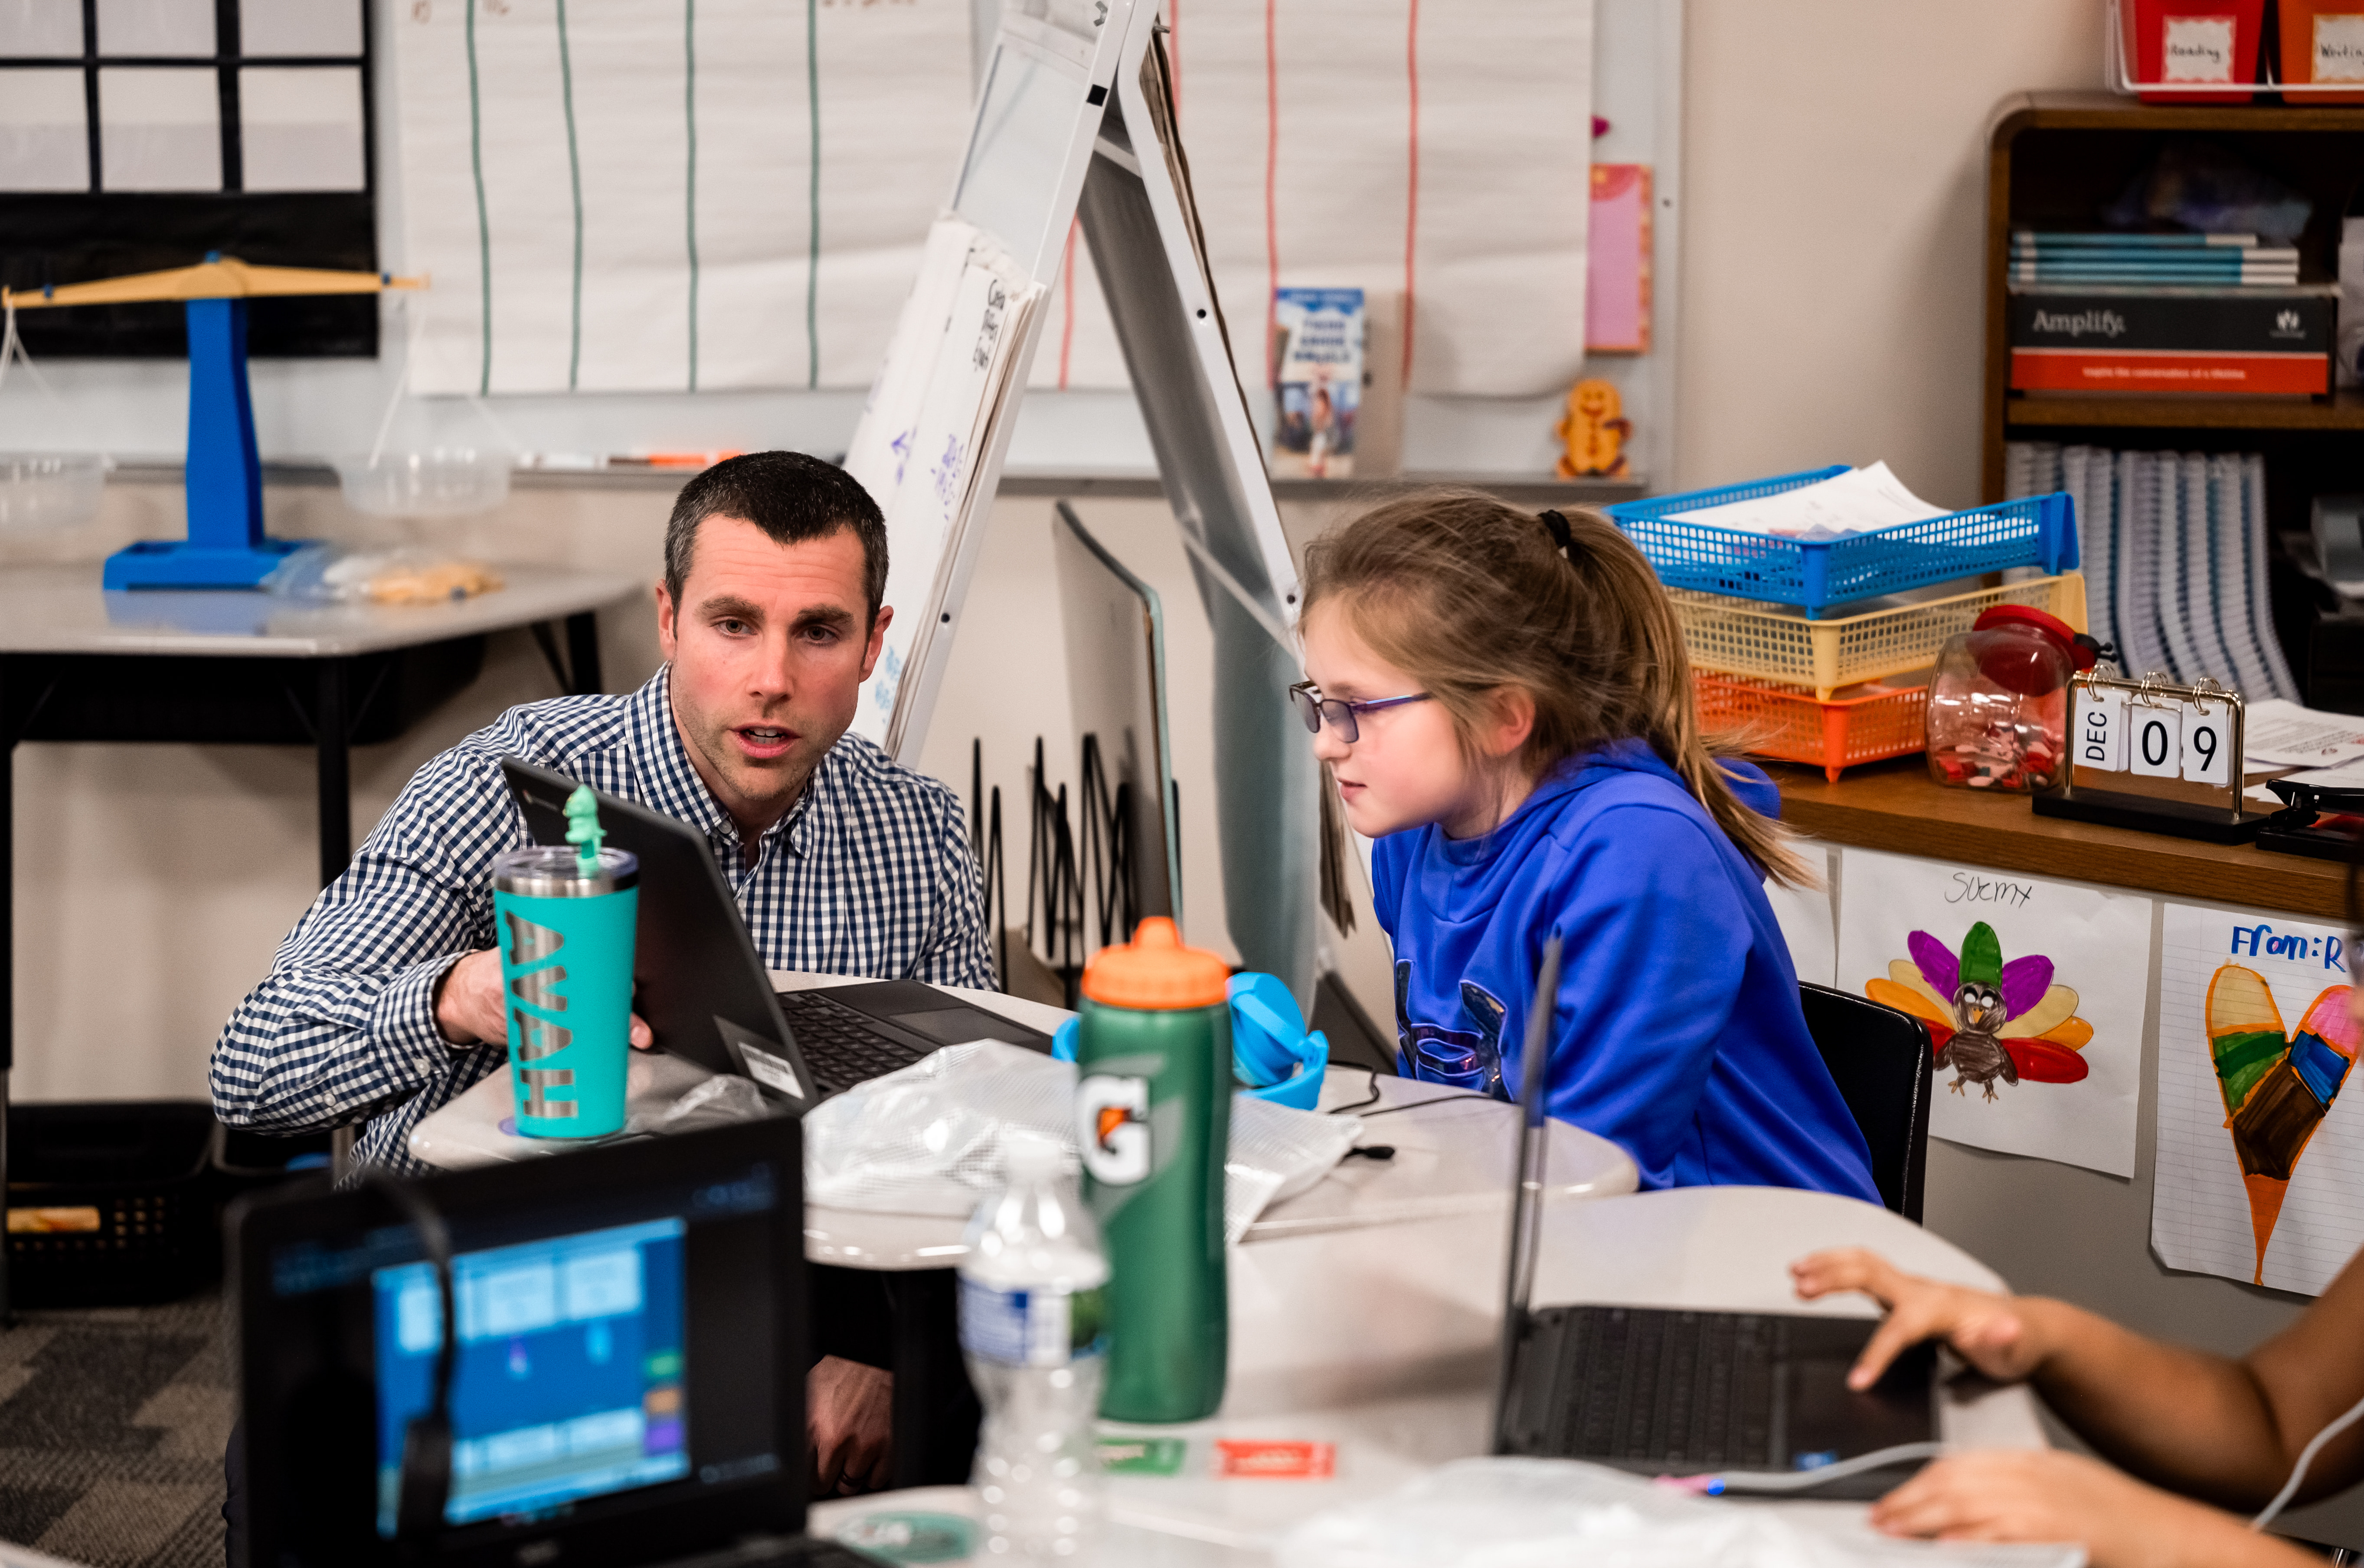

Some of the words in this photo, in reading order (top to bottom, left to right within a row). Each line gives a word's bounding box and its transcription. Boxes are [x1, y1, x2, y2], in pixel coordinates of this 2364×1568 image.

[2086, 712, 2107, 761] DEC
[505, 910, 579, 1118] AVAH
[1078, 1075, 1151, 1185] G
